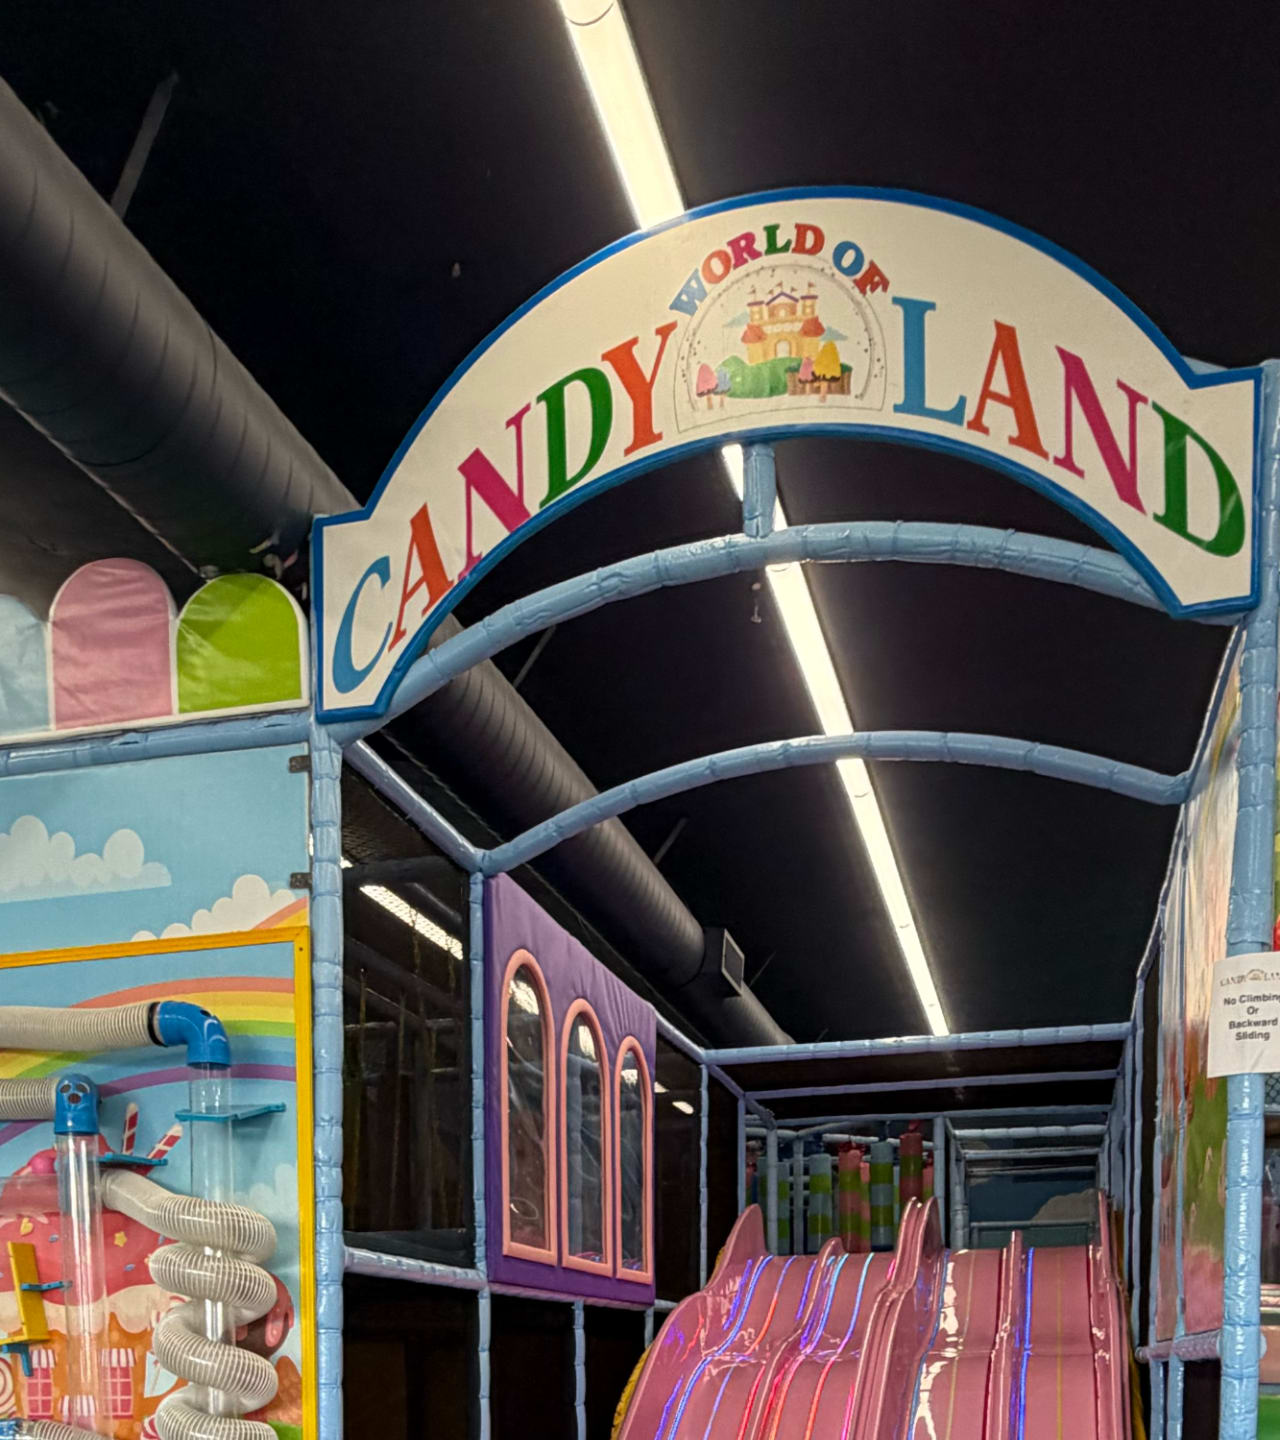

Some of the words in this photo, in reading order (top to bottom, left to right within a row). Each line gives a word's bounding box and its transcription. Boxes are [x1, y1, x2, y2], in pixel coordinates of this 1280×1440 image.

[668, 222, 825, 317] WORLD
[832, 240, 890, 297] OF
[332, 320, 678, 694] CANDY
[891, 296, 1246, 558] LAND
[1224, 997, 1236, 1005] No
[1247, 1006, 1259, 1015] Or
[1229, 1018, 1278, 1029] Backward
[1235, 1031, 1270, 1041] Sliding
